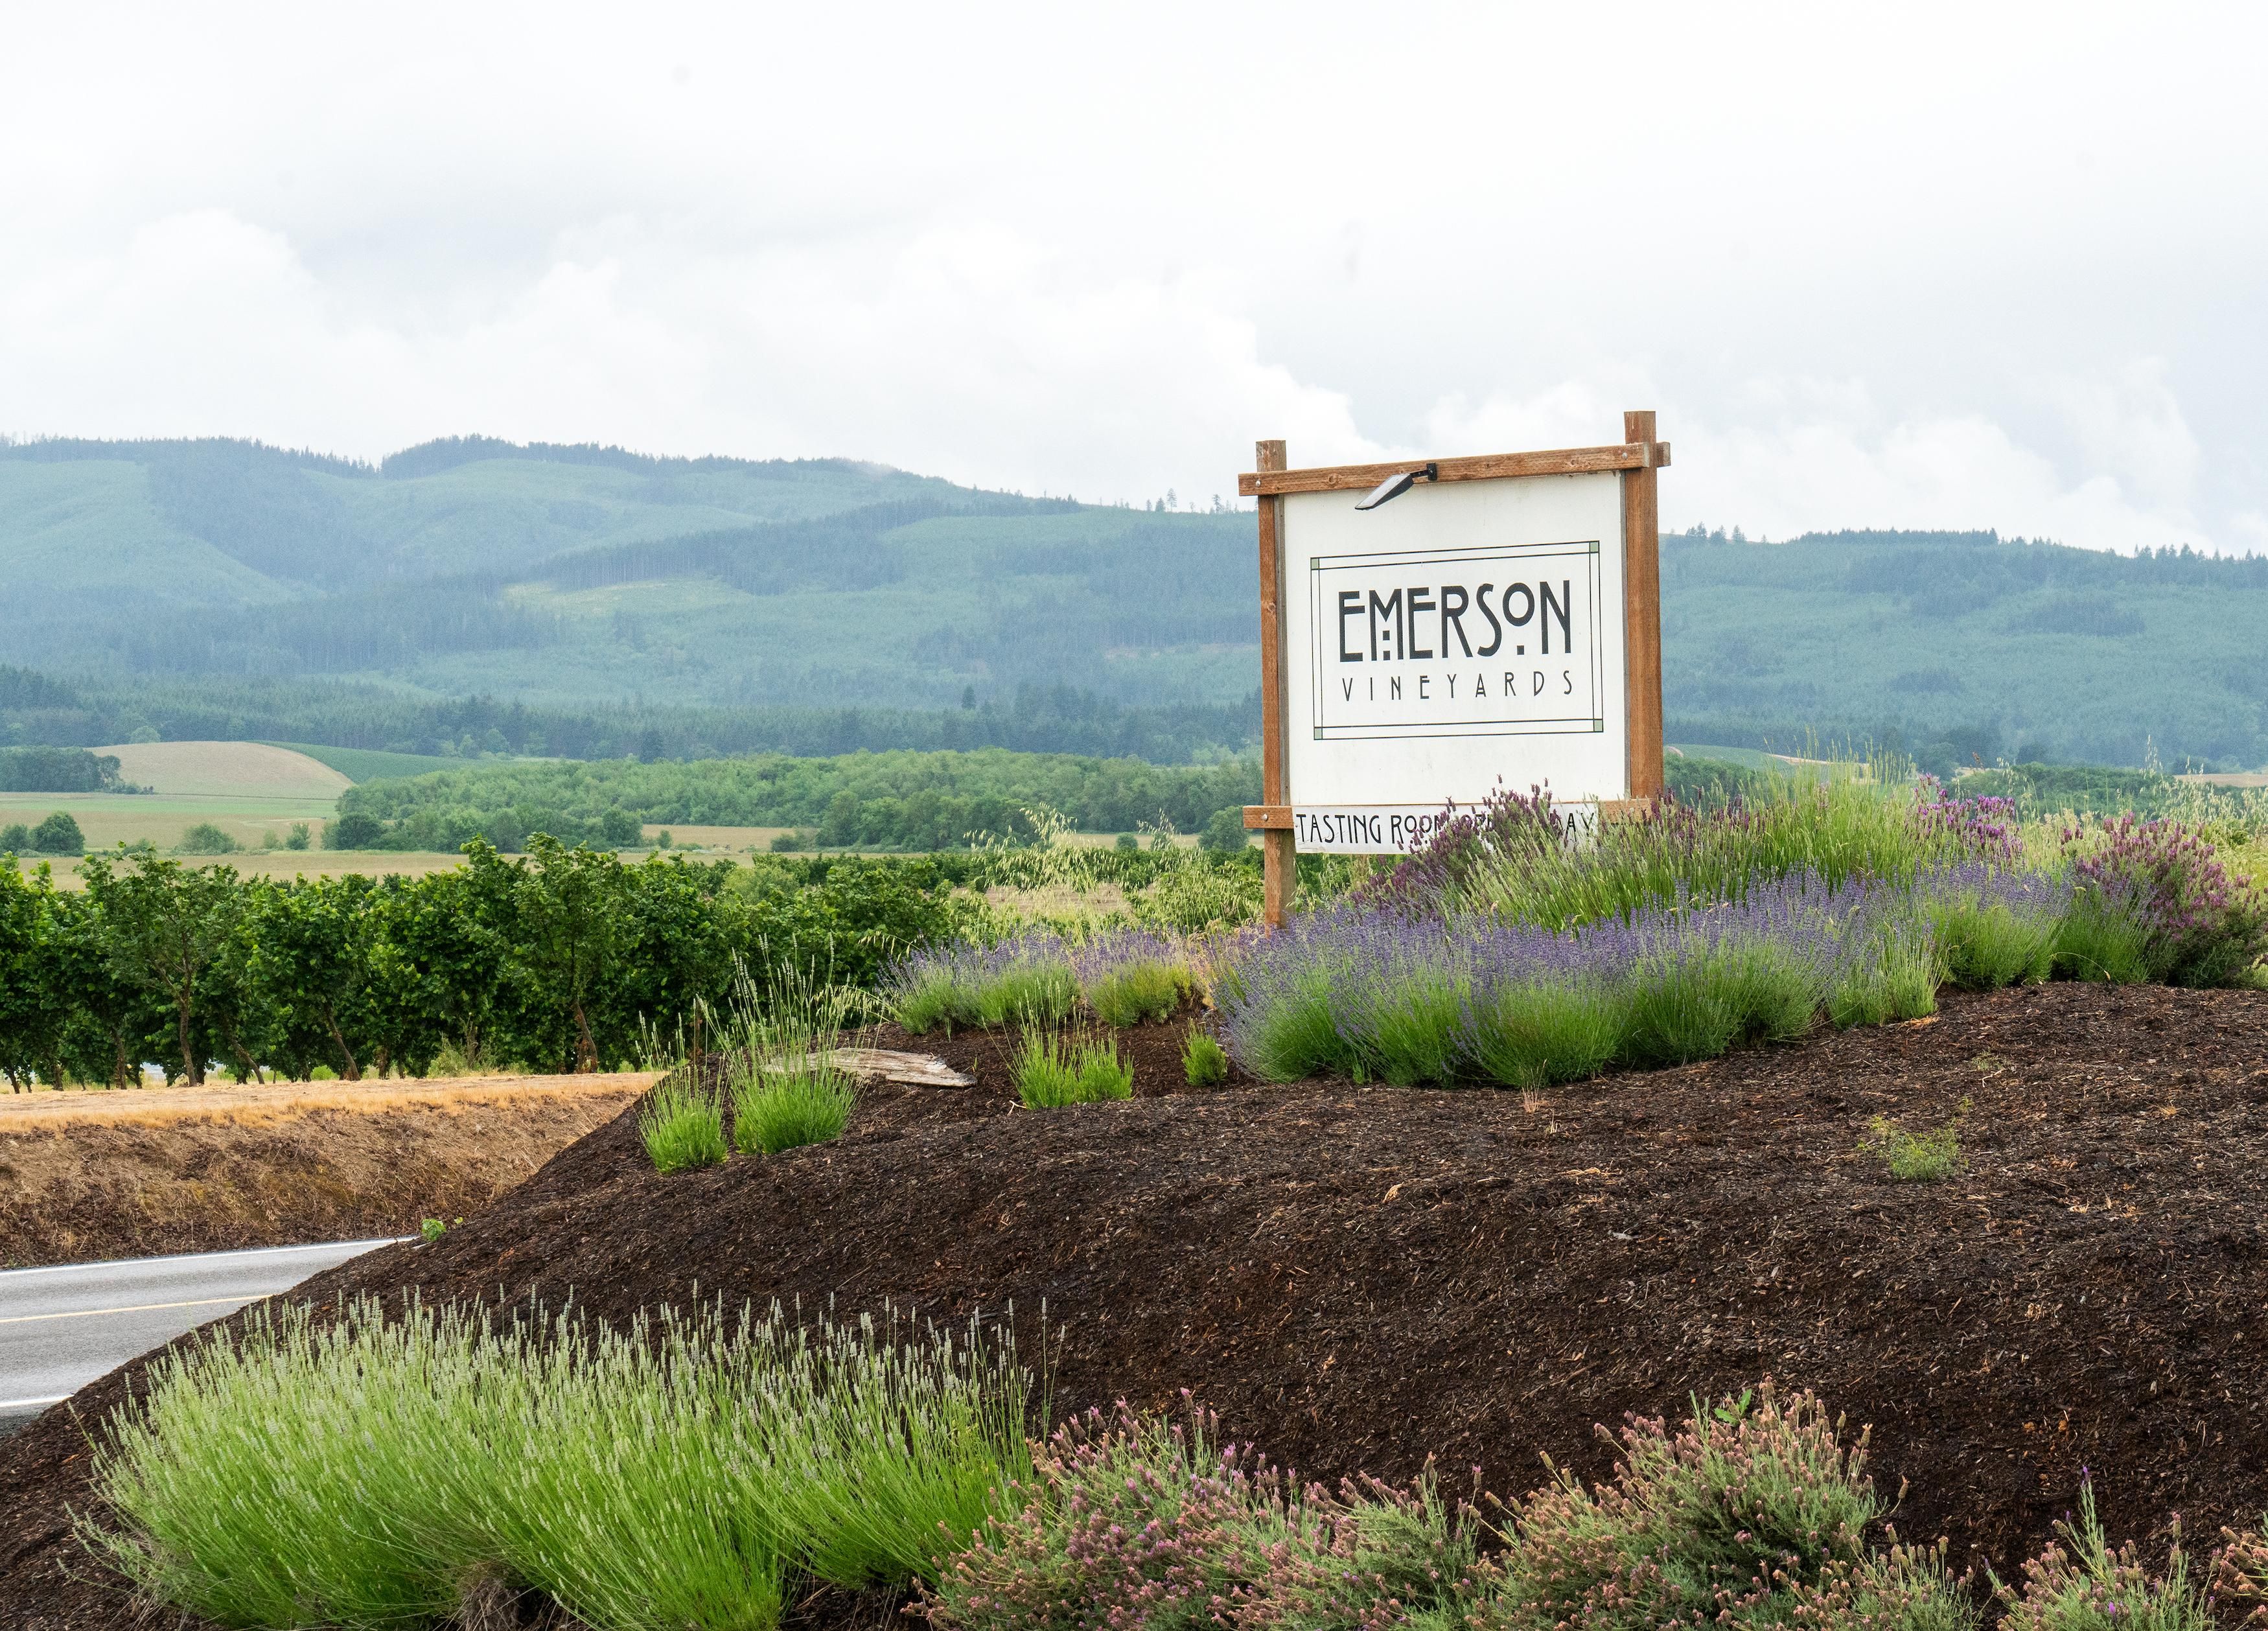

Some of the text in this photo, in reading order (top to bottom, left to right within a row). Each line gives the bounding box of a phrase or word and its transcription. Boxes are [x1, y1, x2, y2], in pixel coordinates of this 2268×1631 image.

[1338, 579, 1571, 662] EMERSON
[1342, 670, 1572, 702] VINEYARDS
[1296, 814, 1382, 844] TASTING
